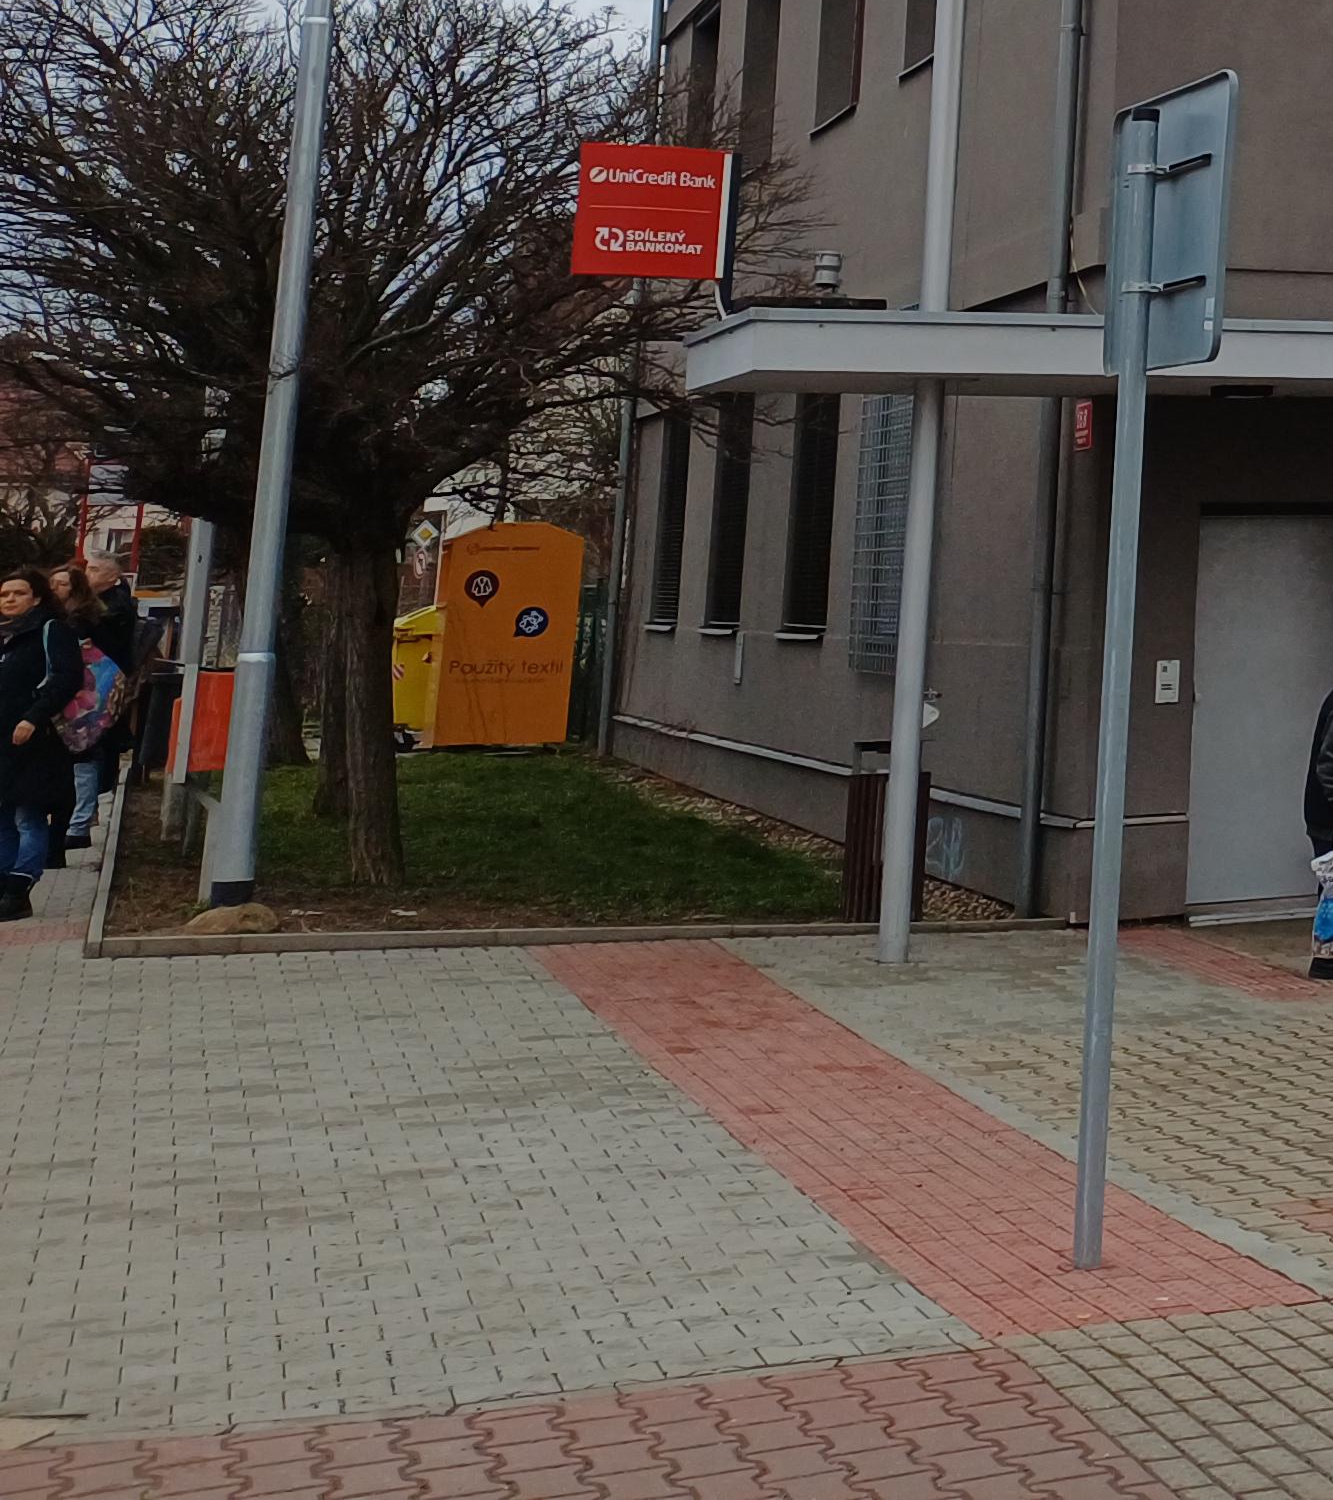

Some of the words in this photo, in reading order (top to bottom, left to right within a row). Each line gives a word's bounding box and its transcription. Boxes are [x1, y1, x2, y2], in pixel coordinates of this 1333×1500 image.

[608, 168, 677, 186] UniCredit
[679, 171, 716, 189] Bank
[625, 227, 687, 243] SDÍLENÝ
[625, 241, 703, 255] BANKOMAT
[521, 659, 564, 676] textil
